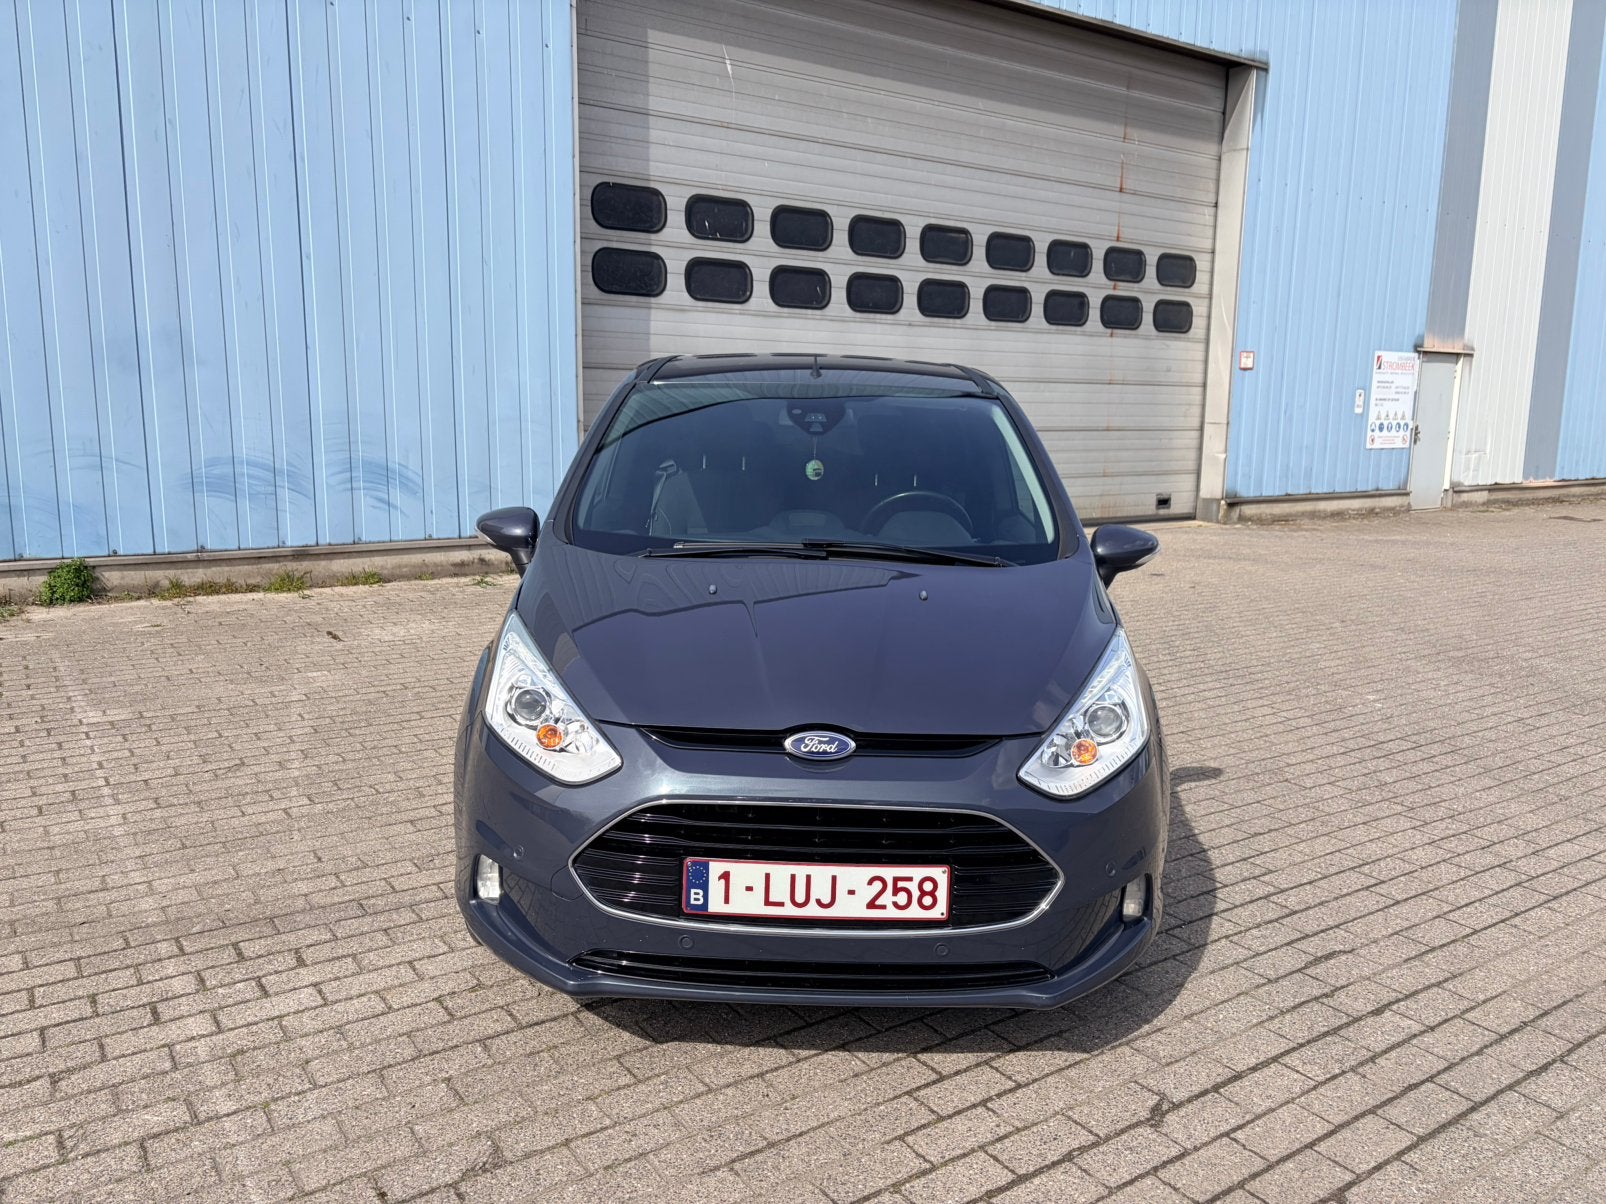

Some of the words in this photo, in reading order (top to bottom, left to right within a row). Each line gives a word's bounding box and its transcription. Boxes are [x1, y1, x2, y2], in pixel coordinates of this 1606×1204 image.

[800, 736, 838, 752] Ford
[689, 888, 704, 905] B
[717, 870, 939, 911] 1-LUJ-258
